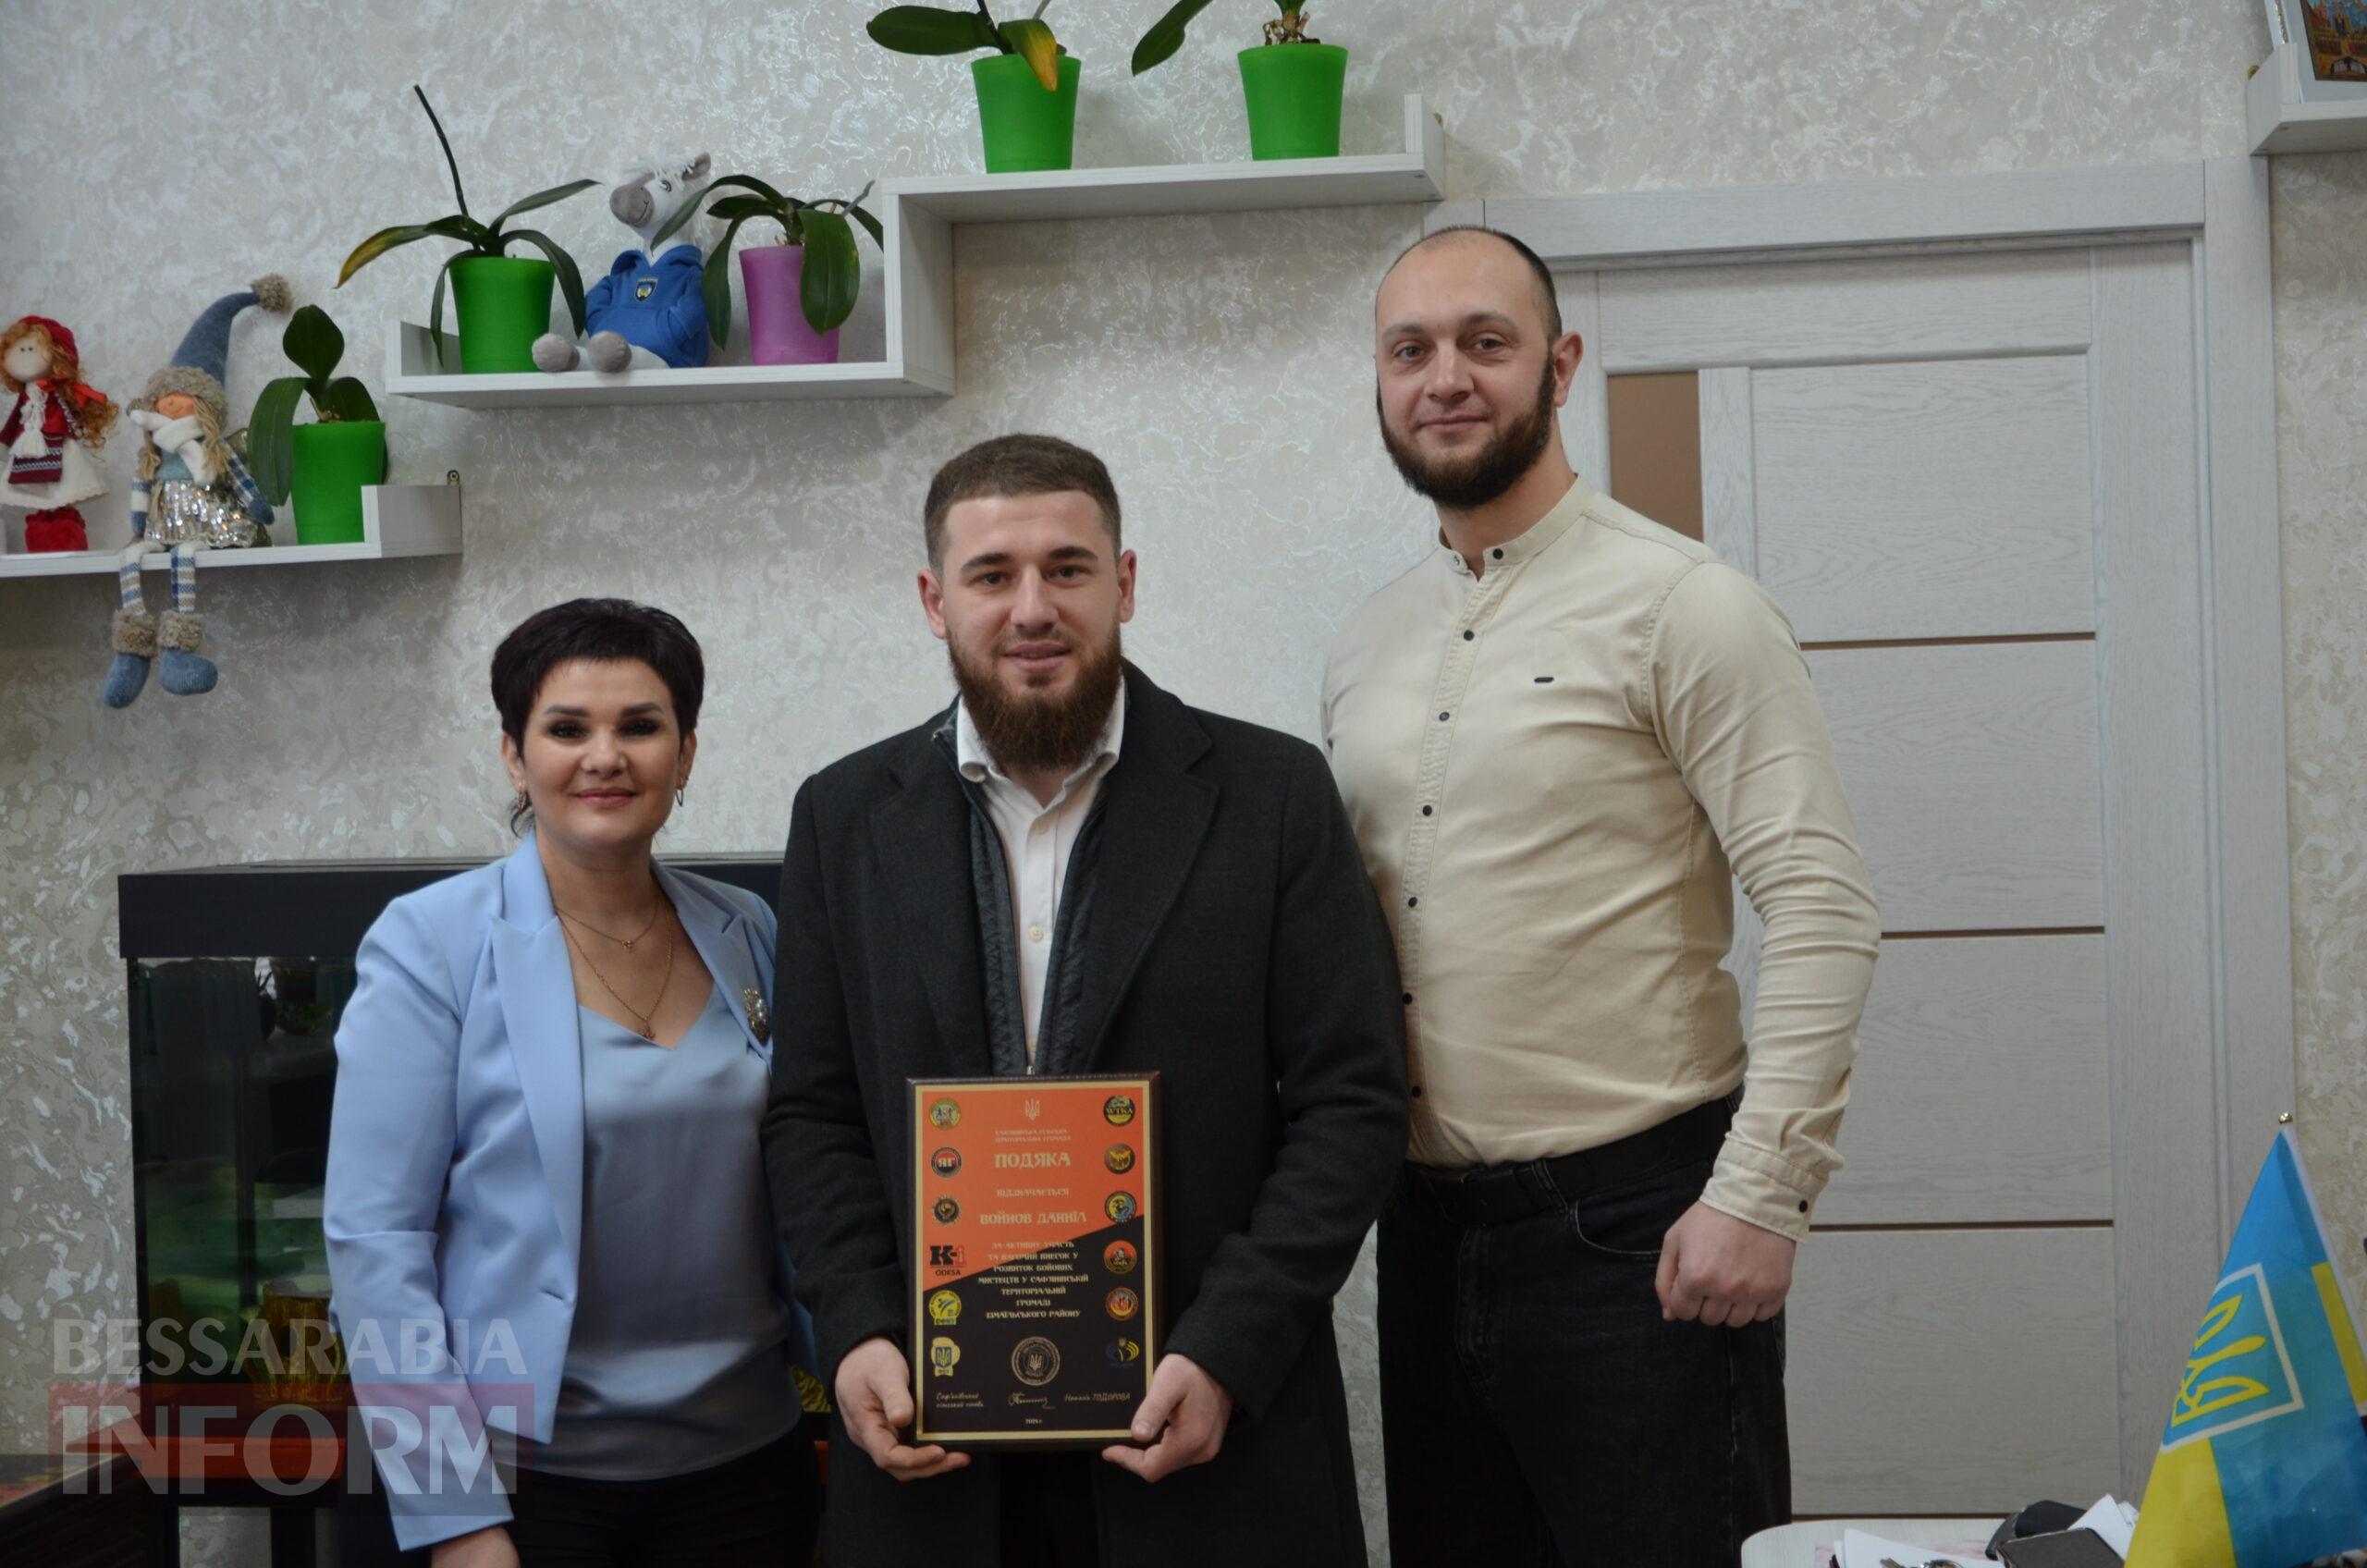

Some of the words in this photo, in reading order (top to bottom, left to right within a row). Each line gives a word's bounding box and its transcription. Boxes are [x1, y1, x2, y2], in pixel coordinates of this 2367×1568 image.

[994, 1153, 1071, 1169] ПОДЯКА
[979, 1211, 1033, 1225] ВОЙНОВ
[1040, 1252, 1071, 1260] ВНЕСОК
[936, 1268, 962, 1277] ODESA
[1000, 1287, 1066, 1295] ТЕРИТОРІАЛЬНІЙ
[1049, 1309, 1081, 1317] РАЙОНУ
